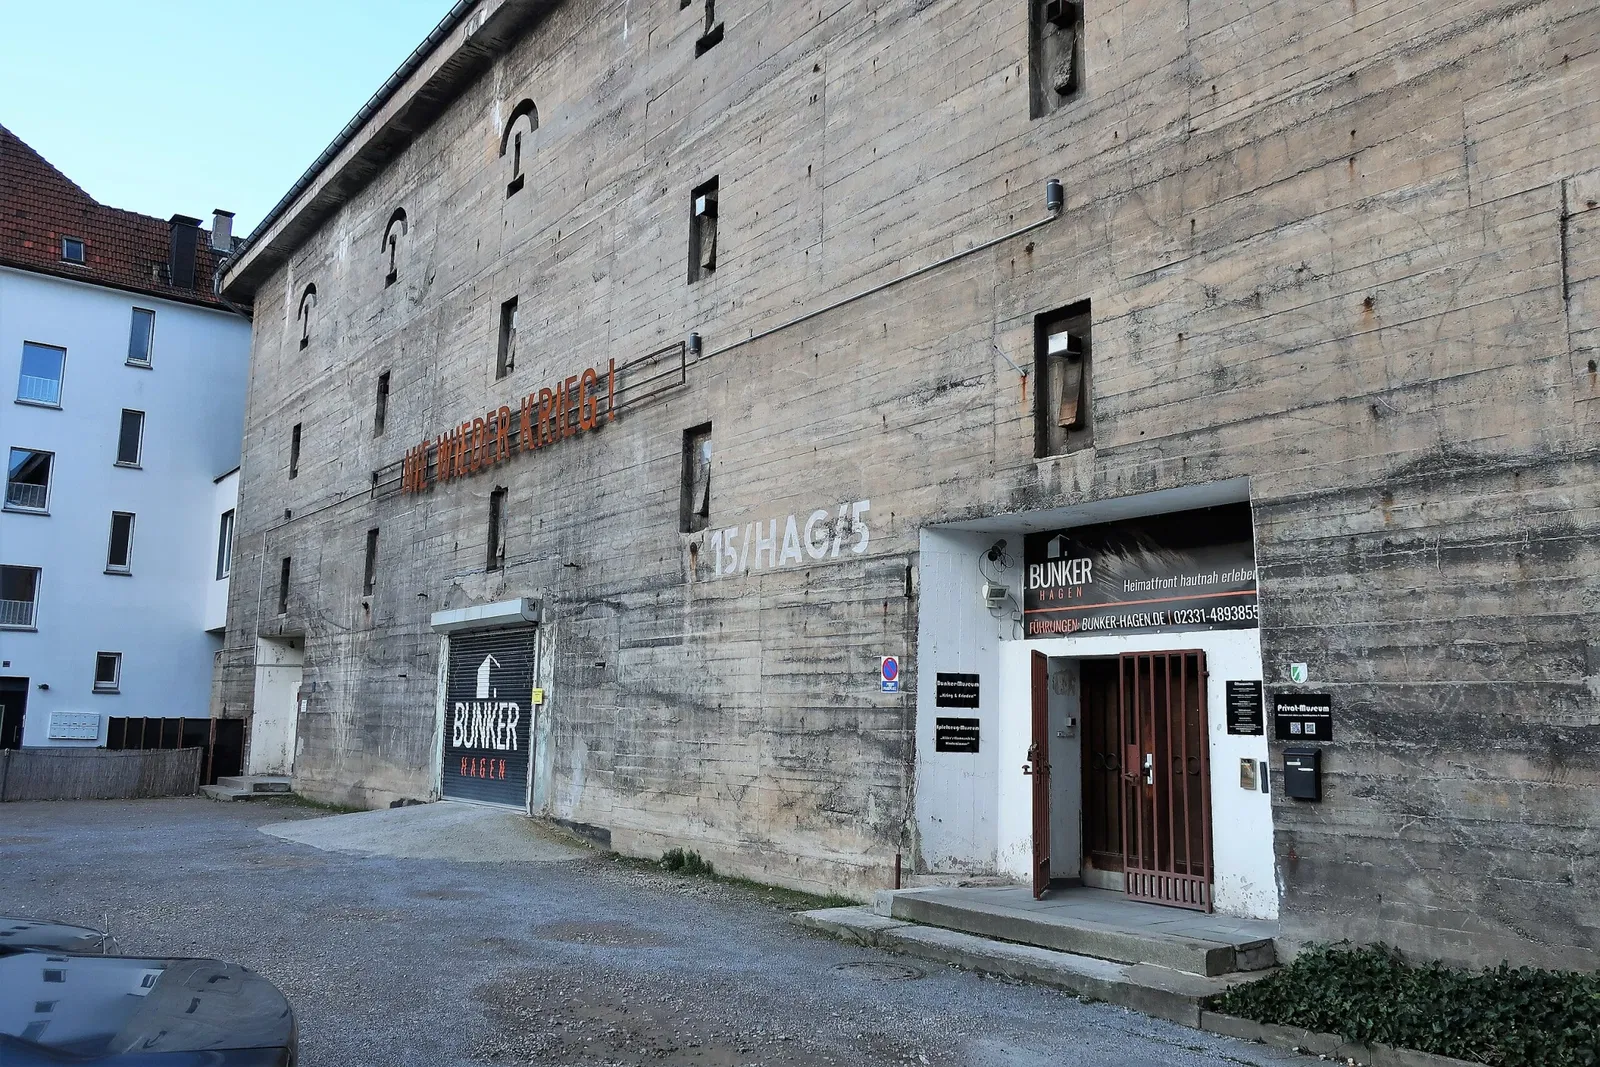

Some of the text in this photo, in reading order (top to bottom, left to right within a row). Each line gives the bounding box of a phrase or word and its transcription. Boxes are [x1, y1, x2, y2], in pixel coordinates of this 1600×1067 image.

[402, 440, 430, 495] NIE
[437, 405, 511, 481] WIEDER
[519, 367, 597, 451] KRIEG
[1029, 557, 1093, 590] BUNKER
[1123, 576, 1177, 593] Heimatfront
[1180, 571, 1219, 586] hautnah
[1039, 586, 1083, 601] HAGEN
[1028, 618, 1080, 636] FÜHRUNGEN:
[1081, 610, 1166, 631] BUNKER-HAGEN.DE
[1173, 604, 1259, 625] 02331-4893855
[1277, 704, 1330, 713] Privat-Museum
[453, 702, 520, 750] BUNKER
[460, 757, 506, 780] HAGEN
